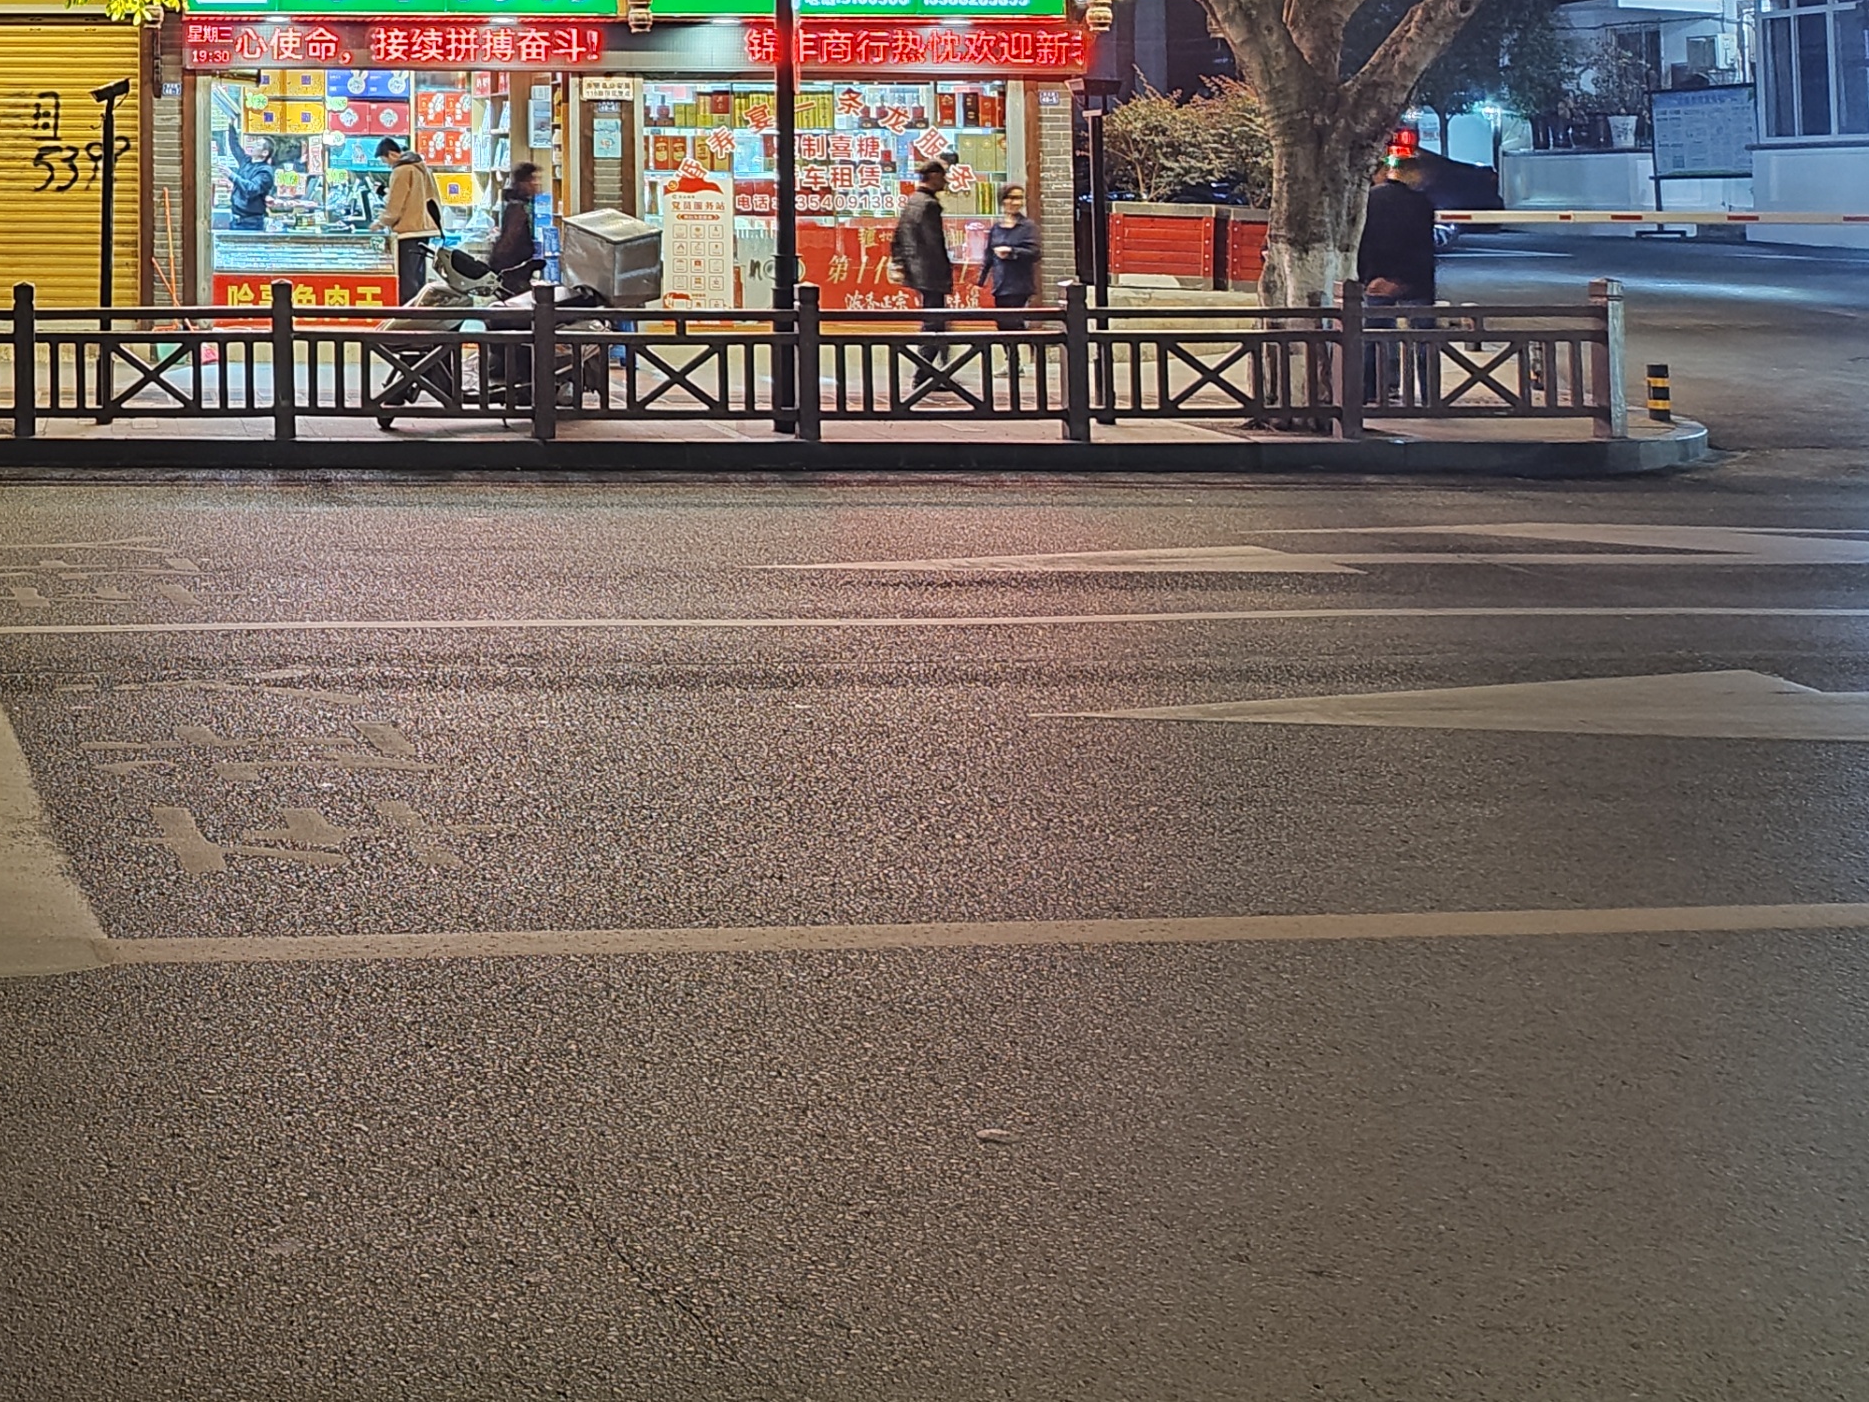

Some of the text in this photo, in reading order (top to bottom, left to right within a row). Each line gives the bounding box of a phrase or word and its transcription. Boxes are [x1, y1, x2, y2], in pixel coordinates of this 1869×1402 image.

[187, 26, 233, 43] 星期三
[192, 49, 229, 63] 19:30
[793, 134, 880, 160] 制喜糖
[793, 165, 881, 190] 车租赁
[671, 201, 725, 211] 党员服务站
